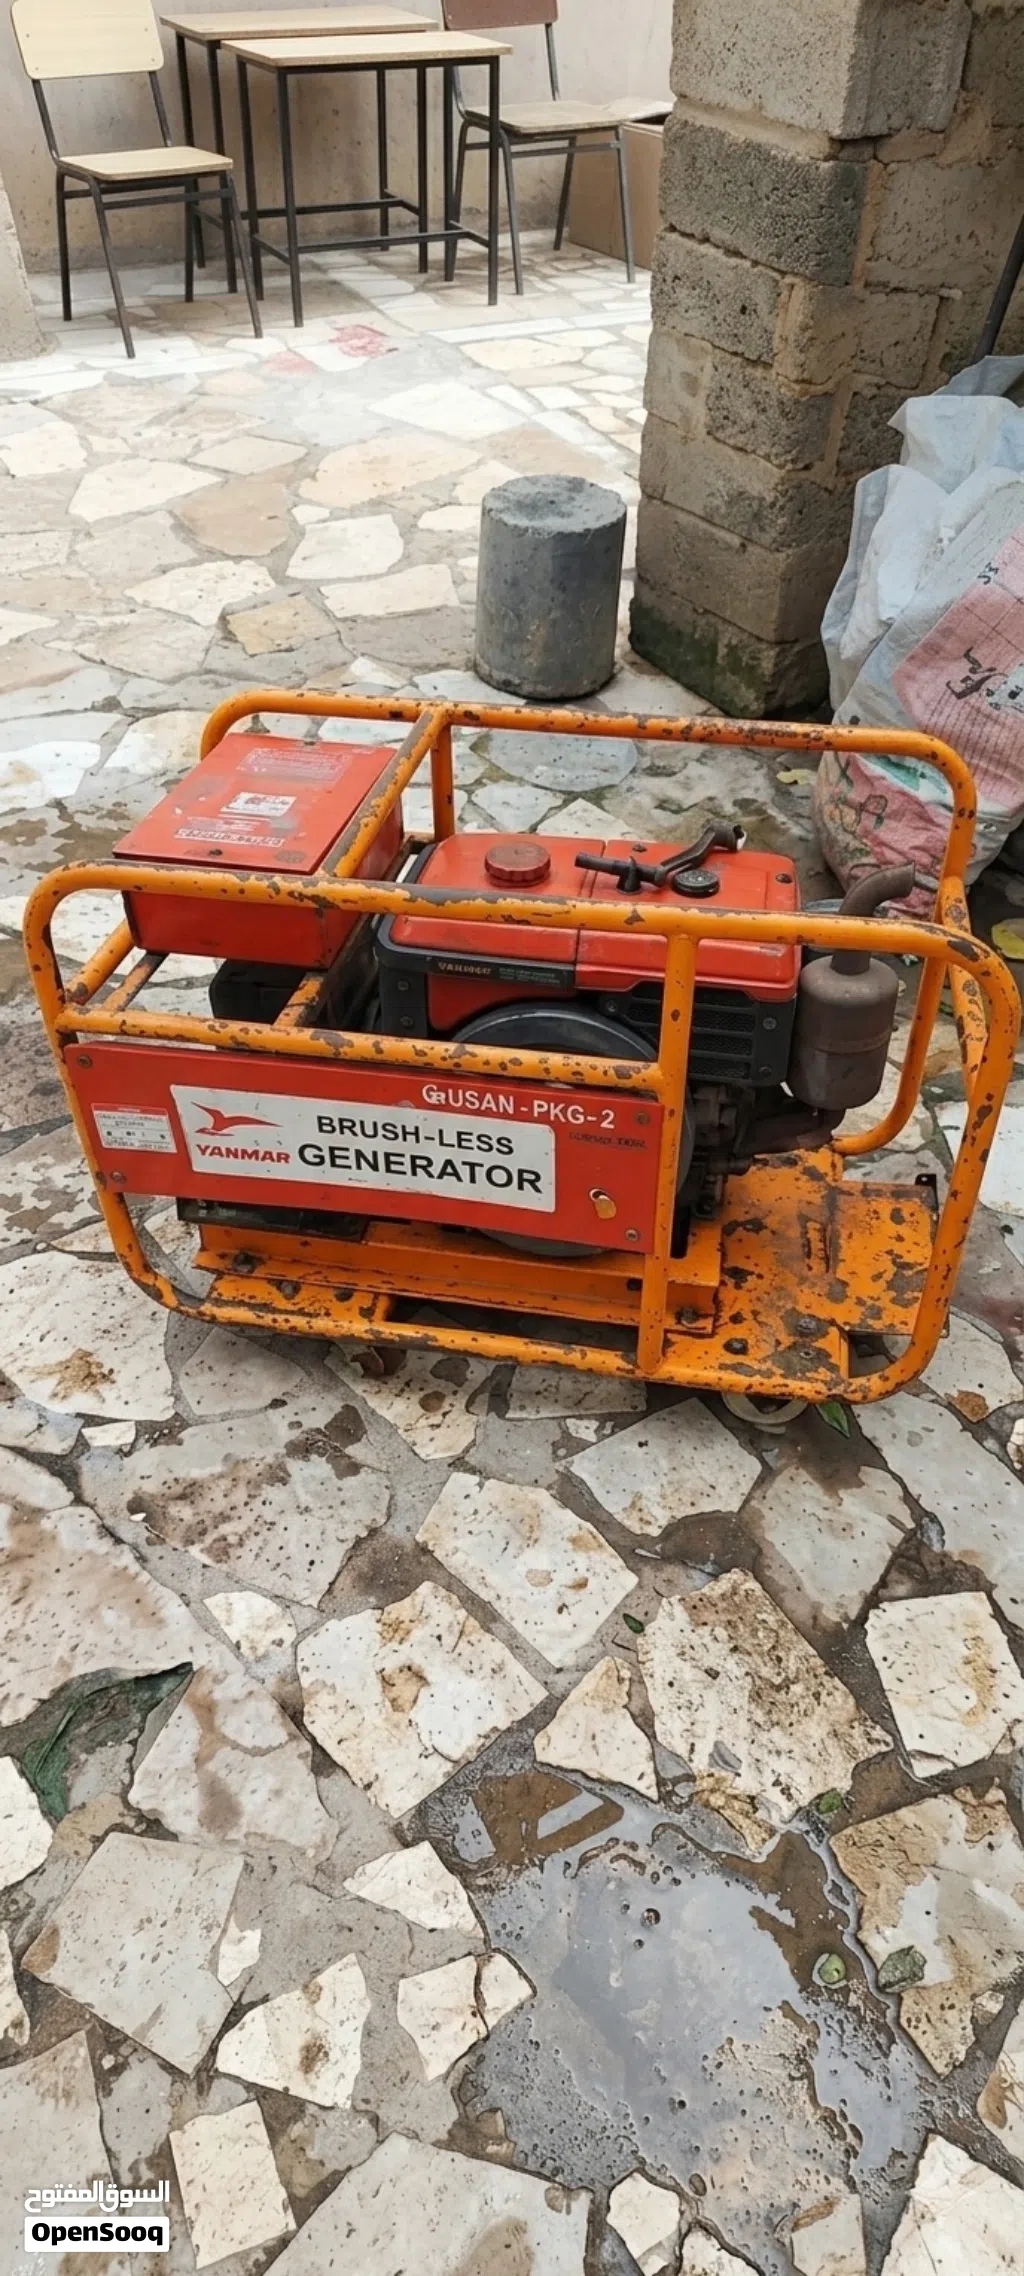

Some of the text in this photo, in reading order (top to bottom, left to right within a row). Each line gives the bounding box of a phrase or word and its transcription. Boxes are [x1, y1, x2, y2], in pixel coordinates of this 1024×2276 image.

[196, 1144, 291, 1164] YANMAR
[317, 1115, 514, 1156] BRUSH-LESS
[297, 1143, 543, 1194] GENERATOR
